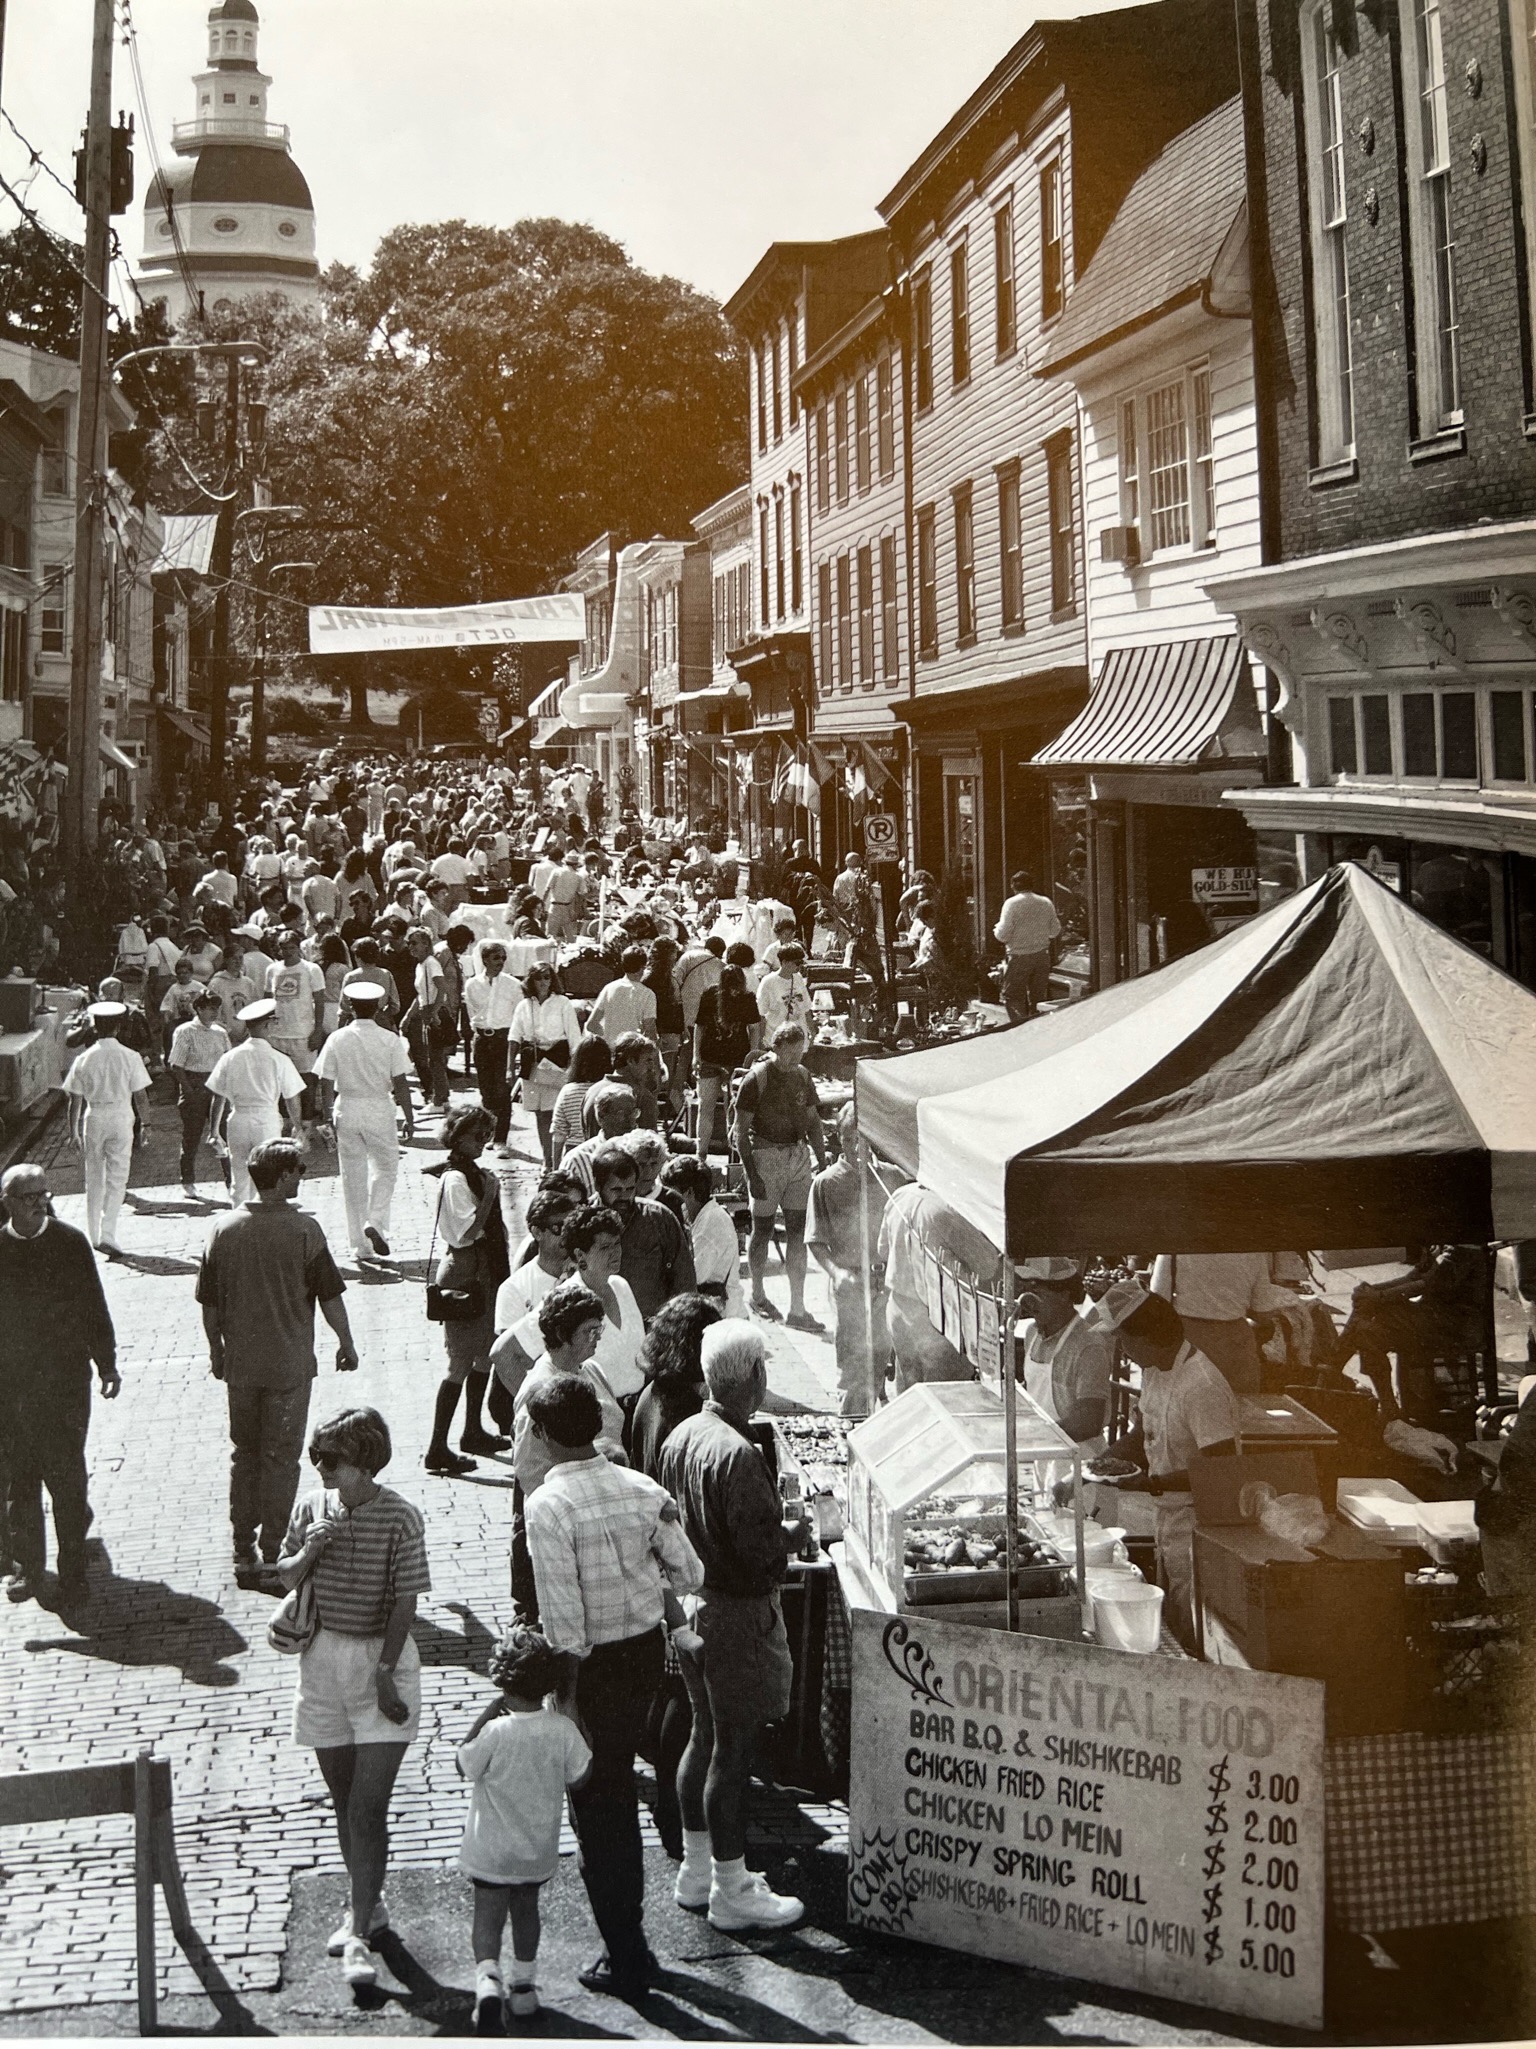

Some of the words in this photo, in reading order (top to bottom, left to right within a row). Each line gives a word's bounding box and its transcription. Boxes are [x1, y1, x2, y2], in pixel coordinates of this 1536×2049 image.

[1206, 869, 1226, 879] WE
[952, 1660, 1172, 1738] ORIENTAL
[1178, 1696, 1275, 1758] FOOD
[909, 1709, 955, 1744] BAR
[1014, 1729, 1036, 1757] &
[1043, 1735, 1182, 1785] SHISHKEBAB
[904, 1747, 987, 1790] CHICKEN
[997, 1765, 1045, 1800] FRIED
[1057, 1776, 1105, 1812] RICE
[1207, 1753, 1231, 1802] $
[1245, 1769, 1300, 1805] 3.00
[904, 1786, 1005, 1833] CHICKEN
[1023, 1810, 1053, 1842] LO
[1061, 1818, 1122, 1858] MEIN
[1204, 1800, 1229, 1837] $
[1244, 1809, 1298, 1846] 2.00
[904, 1827, 982, 1867] CRISPY
[993, 1846, 1076, 1888] SPRING
[1091, 1866, 1148, 1905] ROLL
[1201, 1839, 1226, 1881] $
[1241, 1851, 1299, 1892] 2.00
[1018, 1891, 1061, 1928] FRIED
[1064, 1901, 1105, 1938] RICE
[1126, 1913, 1148, 1946] LO
[1151, 1923, 1195, 1958] MEIN
[1201, 1882, 1223, 1924] $
[1245, 1896, 1296, 1934] 1.00
[1203, 1925, 1225, 1966] $
[1239, 1938, 1295, 1978] 5.00
